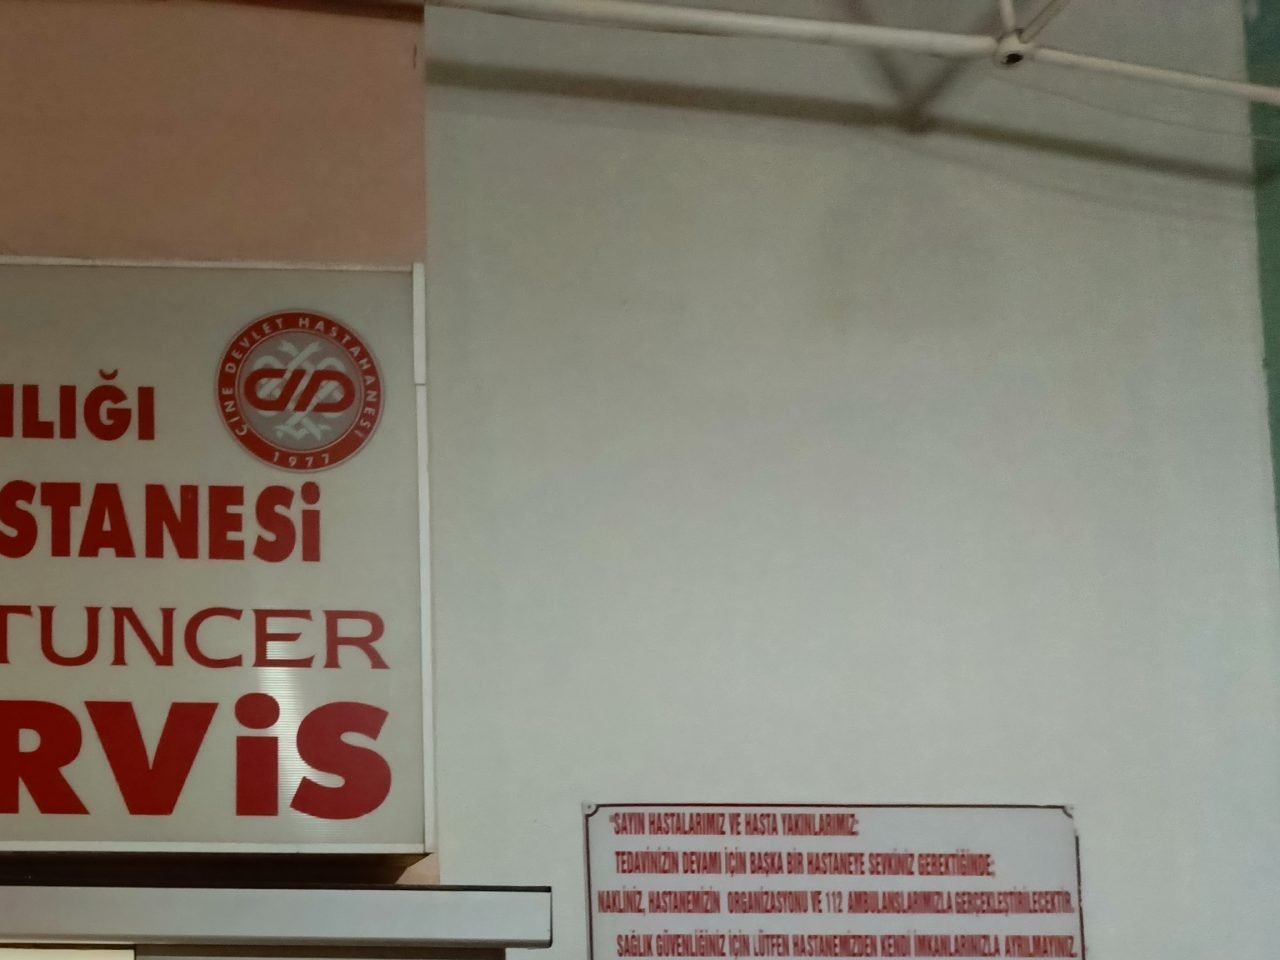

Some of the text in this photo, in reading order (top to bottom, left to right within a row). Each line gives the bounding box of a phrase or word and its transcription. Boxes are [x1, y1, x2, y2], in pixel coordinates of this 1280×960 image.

[225, 318, 283, 374] DEVLET
[273, 452, 330, 468] 1977
[648, 812, 726, 836] HASTALARIMIZ
[729, 813, 742, 835] VE
[745, 813, 778, 836] HASTA
[683, 850, 722, 875] DEVAMI
[725, 847, 747, 877] İÇİN
[750, 851, 784, 877] BAŞKA
[787, 848, 804, 875] BİR
[807, 852, 865, 876] HASTANEYE
[811, 890, 823, 913] VE
[826, 890, 844, 914] 112
[617, 930, 653, 957] SAĞLIK
[729, 929, 750, 960] İÇİN
[753, 929, 790, 957] LÜTFEN
[880, 930, 911, 957] KENDİ
